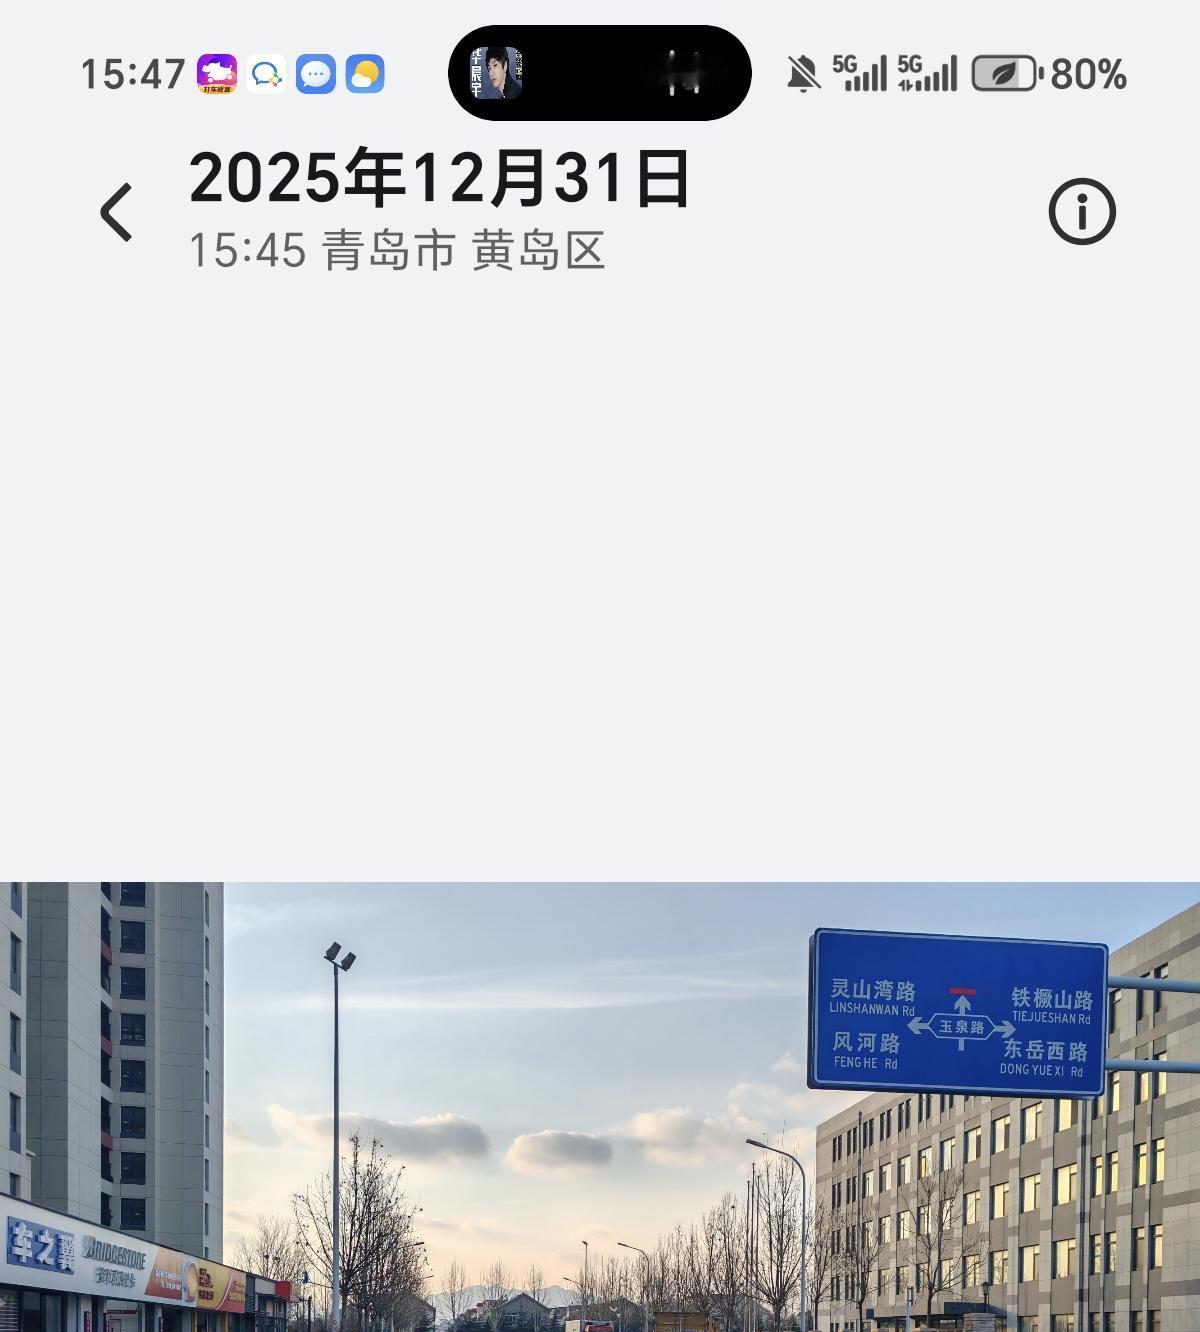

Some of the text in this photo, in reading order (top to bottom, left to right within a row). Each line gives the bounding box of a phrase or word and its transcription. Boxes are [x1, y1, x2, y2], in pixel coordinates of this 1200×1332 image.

[831, 978, 916, 1002] 灵山湾路
[1011, 986, 1093, 1011] 铁橛山路
[829, 1002, 915, 1017] LINSHANWAN Rd
[1012, 1010, 1091, 1025] TIEJUESHAN Rd
[939, 1018, 985, 1035] 玉泉路
[833, 1031, 900, 1054] 风河路
[1003, 1038, 1088, 1063] 东岳西路
[885, 1058, 898, 1070] Rd
[1071, 1066, 1083, 1078] Rd
[12, 1221, 75, 1272] 车之翼
[82, 1234, 147, 1271] BRIDGESTONE
